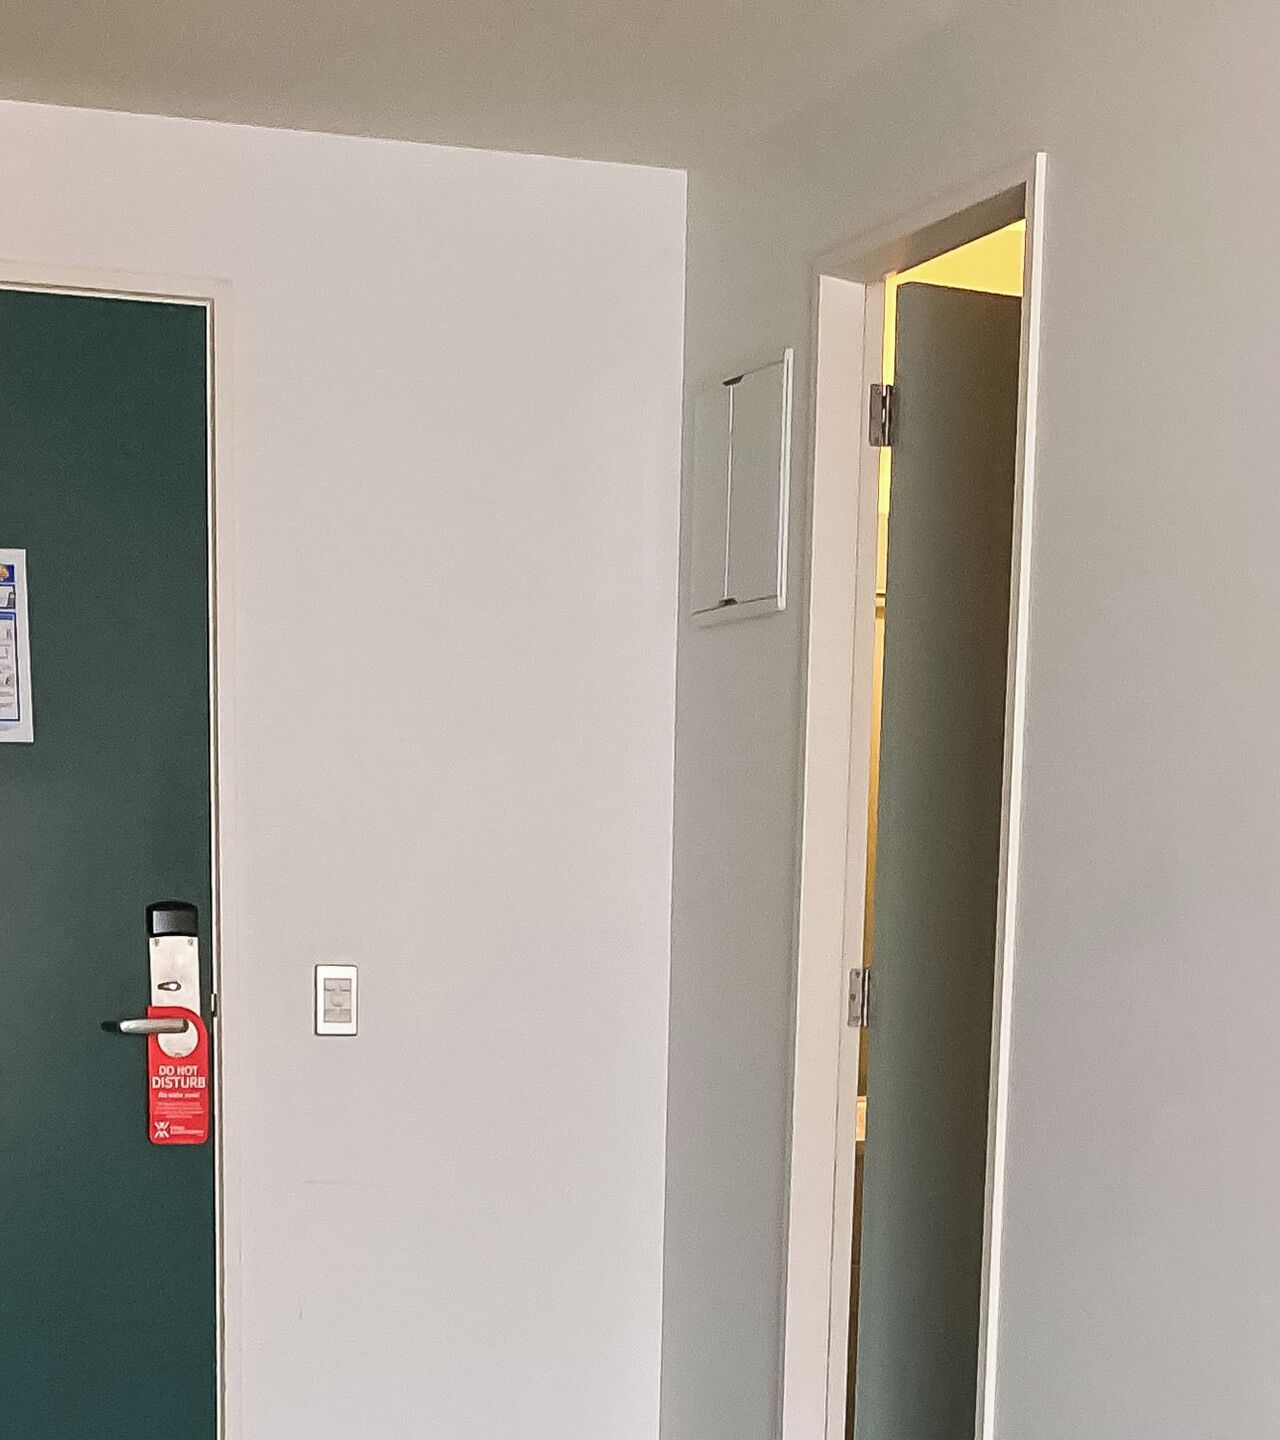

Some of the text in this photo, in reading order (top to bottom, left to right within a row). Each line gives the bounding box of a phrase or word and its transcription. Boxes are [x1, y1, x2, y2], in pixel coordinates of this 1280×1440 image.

[158, 1065, 198, 1076] DO NOT
[152, 1076, 206, 1089] DISTURB
